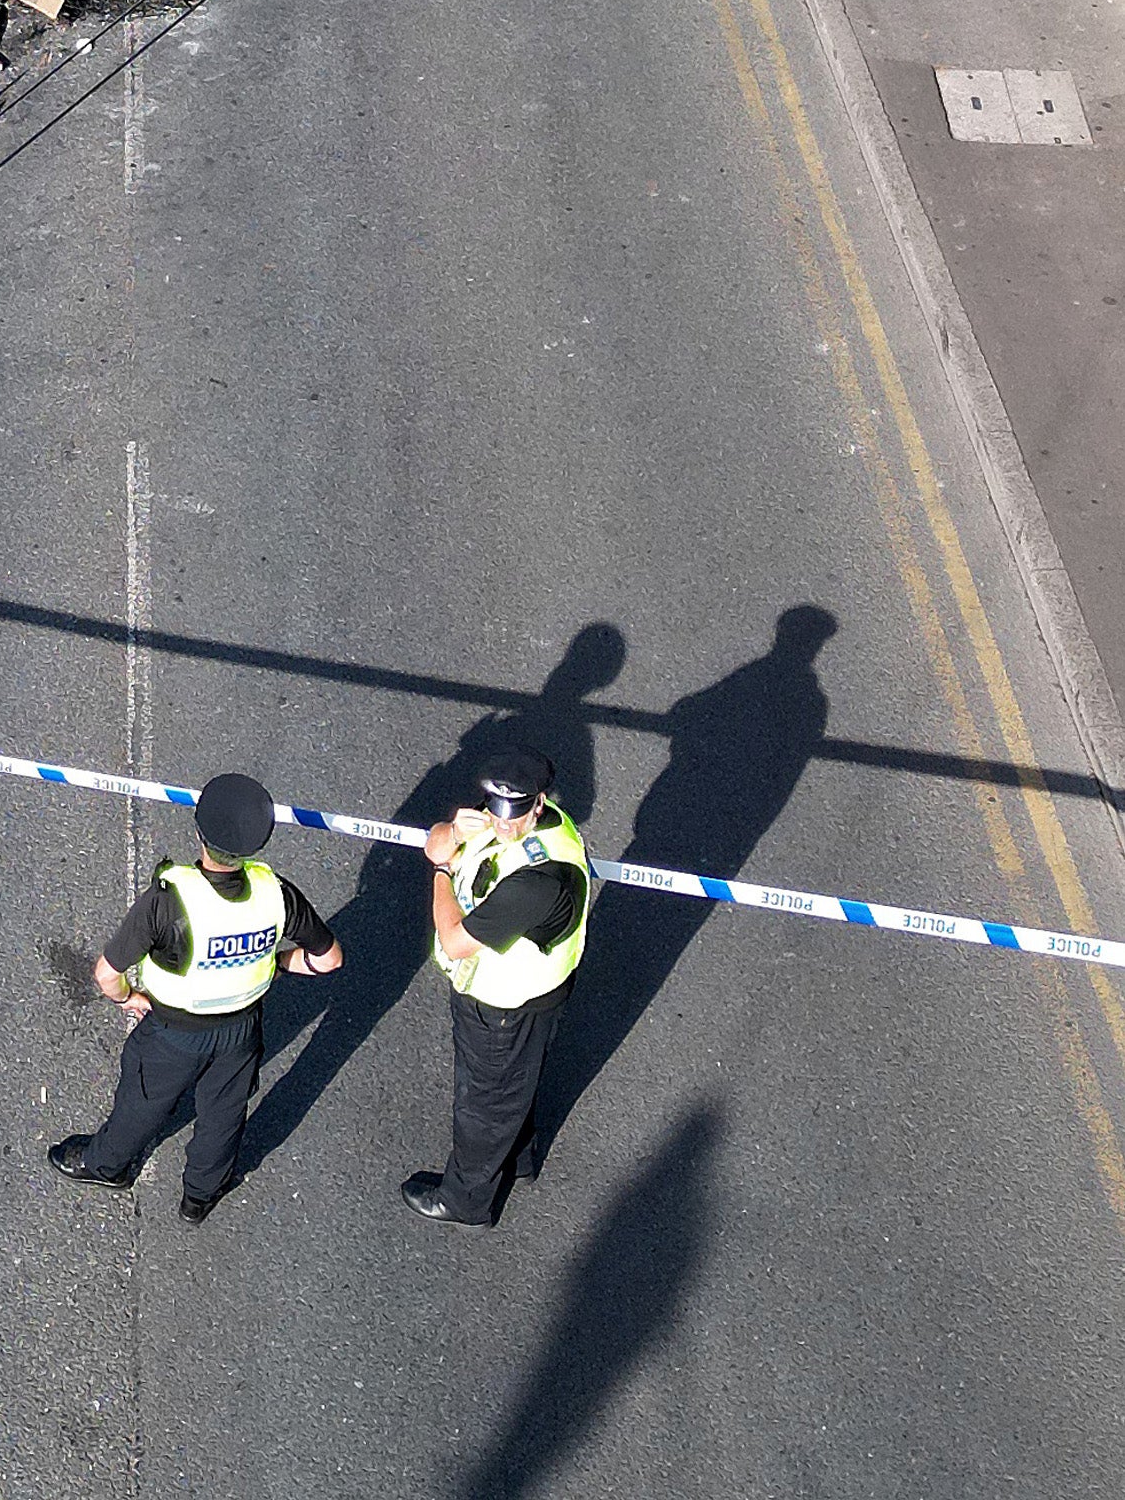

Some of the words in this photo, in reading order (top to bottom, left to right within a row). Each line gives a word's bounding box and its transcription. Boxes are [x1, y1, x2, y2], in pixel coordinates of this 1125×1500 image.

[92, 777, 141, 796] POLICE
[352, 822, 403, 841] POLICE
[622, 867, 674, 888] POLICE
[761, 891, 814, 912] POLICE
[902, 913, 957, 935] POLICE
[209, 928, 276, 958] POLICE
[1046, 936, 1103, 958] POLICE
